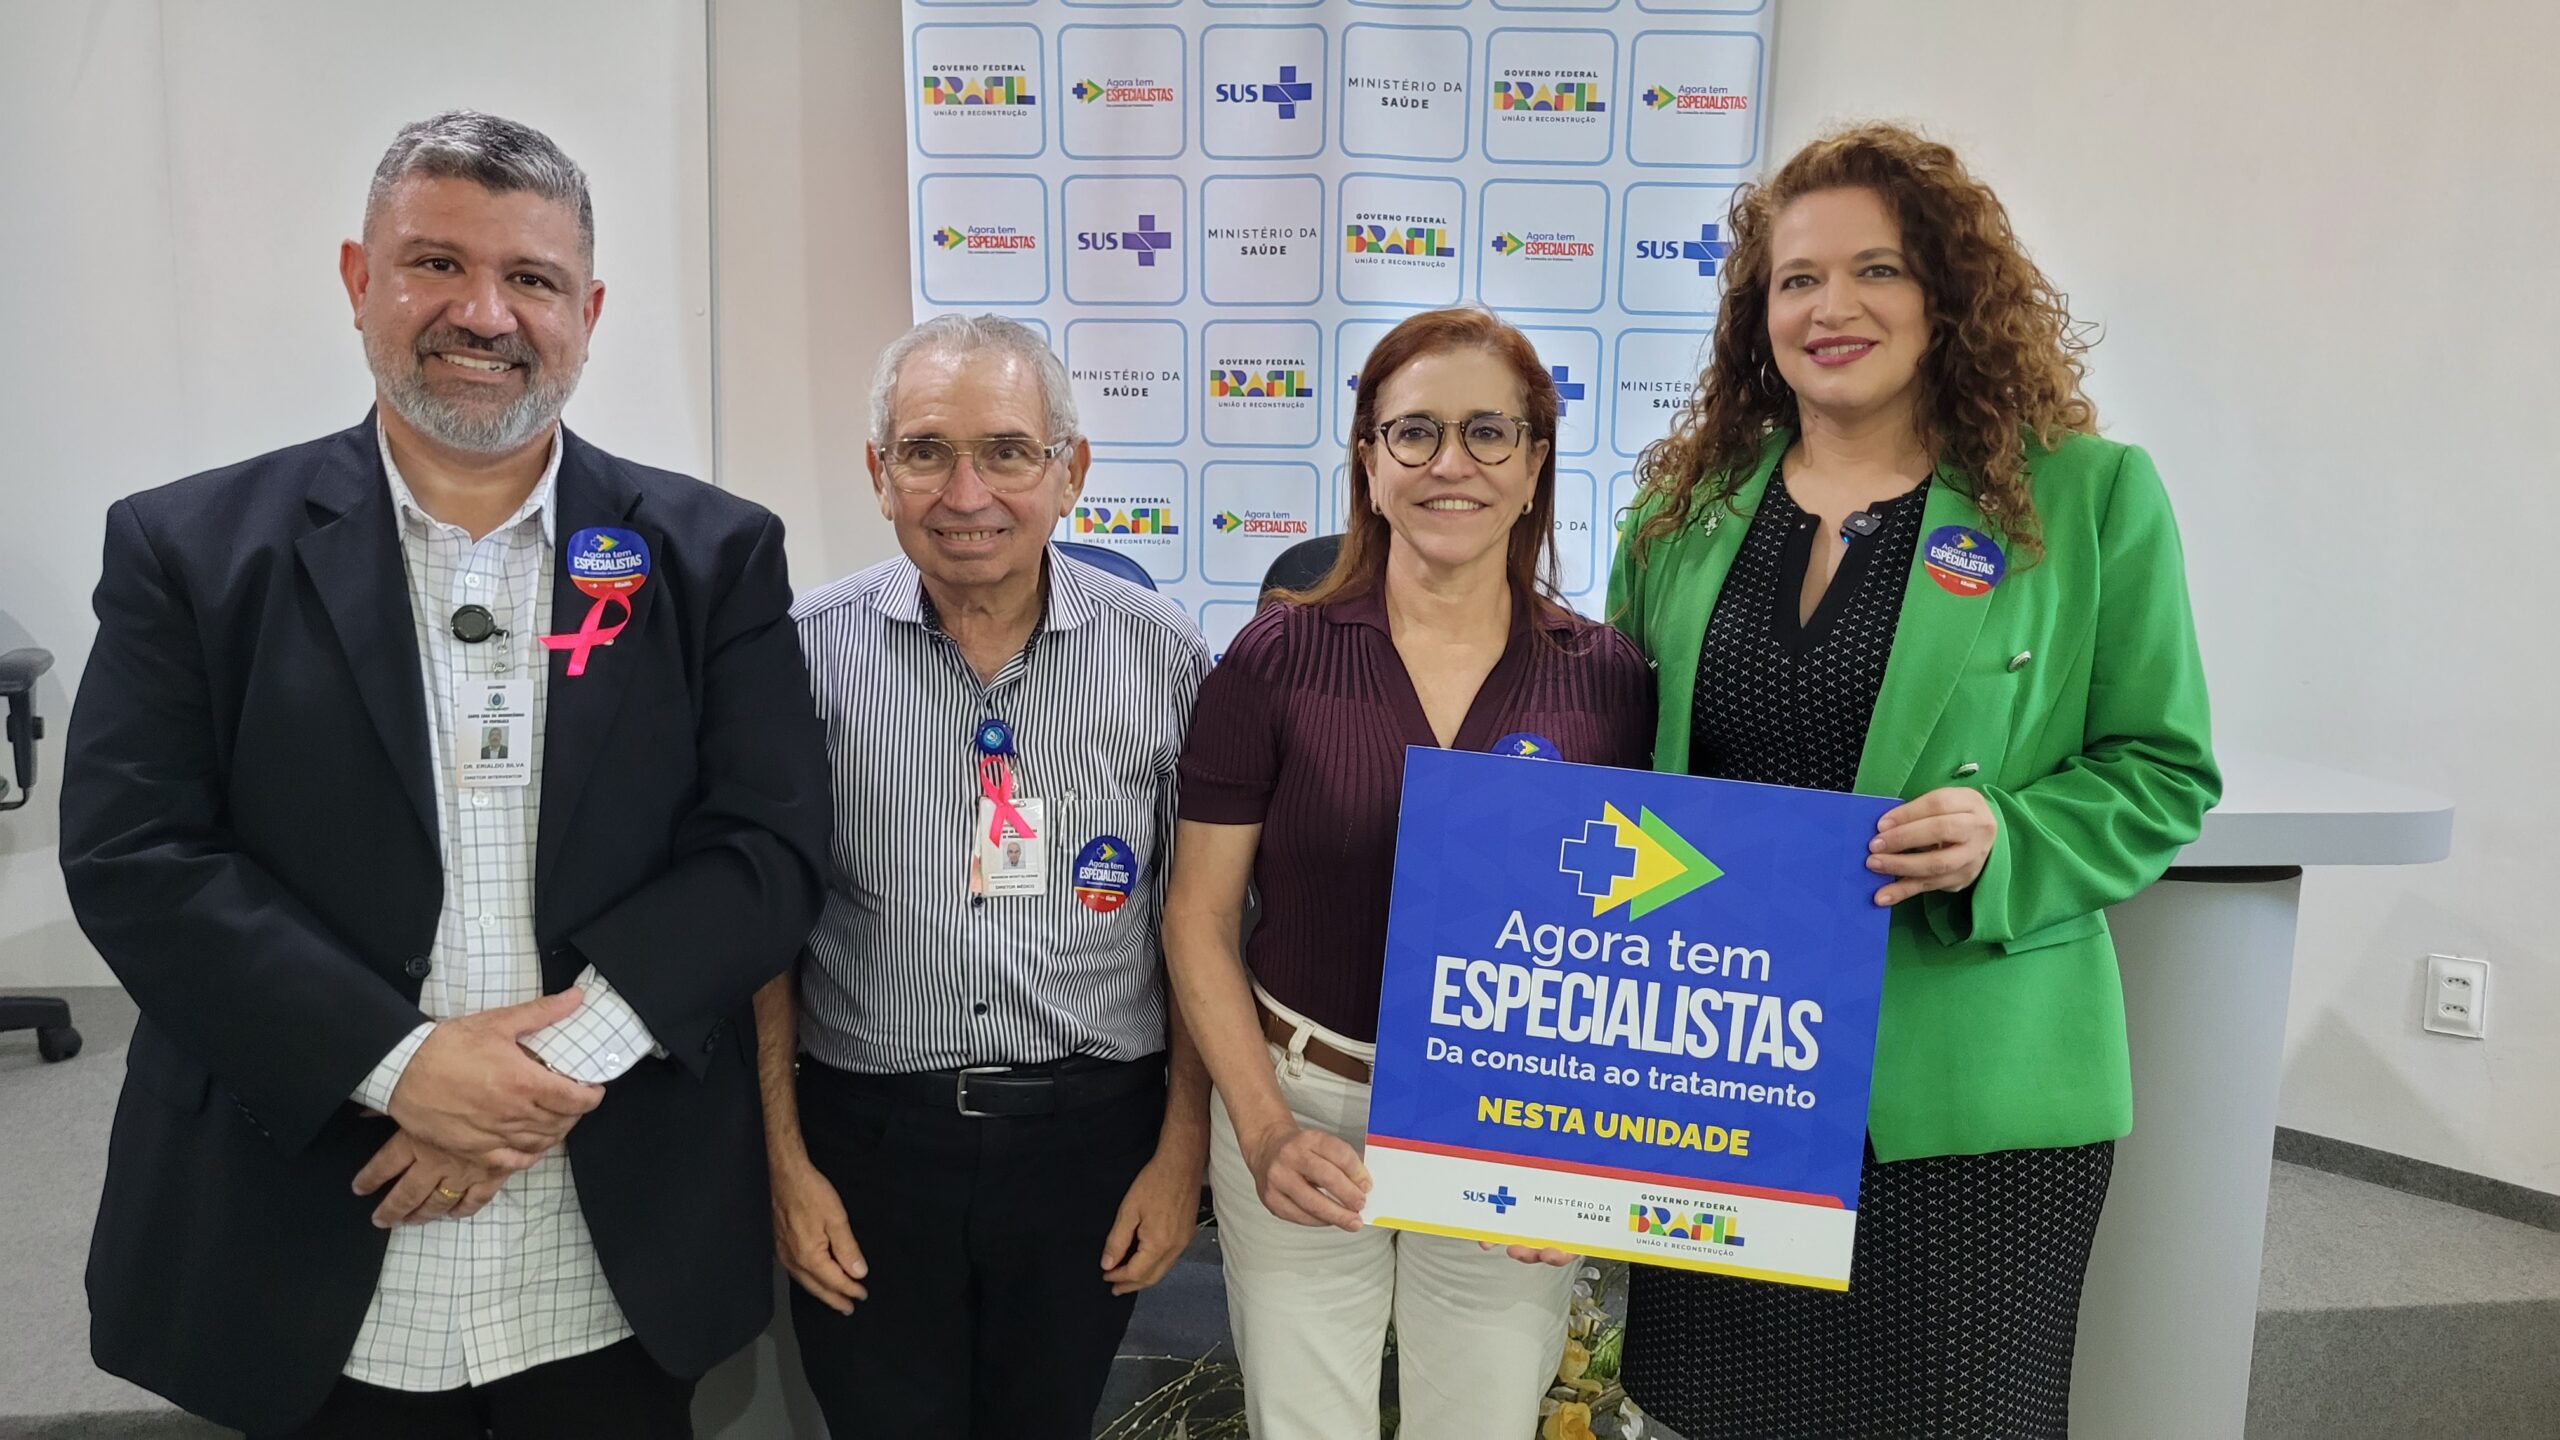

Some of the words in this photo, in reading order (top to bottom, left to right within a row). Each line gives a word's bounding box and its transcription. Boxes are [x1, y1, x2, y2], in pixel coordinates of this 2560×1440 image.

[1504, 69, 1551, 77] GOVERNO
[1555, 70, 1599, 78] FEDERAL
[1106, 78, 1134, 88] Agora
[1135, 78, 1154, 86] tem
[1348, 77, 1437, 92] MINISTÉRIO
[1443, 82, 1463, 92] DA
[923, 76, 1036, 105] BRASIL
[1106, 88, 1174, 102] ESPECIALISTAS
[1216, 84, 1258, 102] SUS
[1493, 81, 1606, 112] BRASIL
[1678, 85, 1707, 96] Agora
[1709, 86, 1728, 94] tem
[1381, 95, 1429, 109] SAÚDE
[1677, 95, 1748, 110] ESPECIALISTAS
[934, 109, 958, 117] UNIÃO
[959, 109, 965, 117] E
[968, 109, 1028, 117] RECONSTRUÇÃO
[1536, 116, 1596, 124] RECONSTRUÇÃO
[1356, 213, 1402, 221] GOVERNO
[1405, 216, 1447, 224] FEDERAL
[967, 225, 995, 235] Agora
[1208, 226, 1294, 239] MINISTÉRIO
[1299, 228, 1317, 238] DA
[1526, 231, 1554, 242] Agora
[1556, 233, 1575, 241] tem
[967, 235, 1036, 249] ESPECIALISTAS
[1077, 232, 1118, 250] SUS
[1346, 225, 1455, 257] BRASIL
[1240, 243, 1287, 256] SAÚDE
[1525, 242, 1594, 256] ESPECIALISTAS
[1636, 240, 1679, 260] SUS
[1388, 259, 1446, 268] RECONSTRUÇÃO
[1072, 368, 1155, 381] MINISTÉRIO
[1162, 371, 1181, 381] DA
[1210, 370, 1313, 397] BRASIL
[1621, 381, 1697, 392] MINISTÉR
[1103, 385, 1149, 397] SAÚDE
[1075, 507, 1179, 534] BRASIL
[1245, 510, 1271, 520] Agora
[1273, 511, 1290, 519] tem
[1244, 520, 1307, 534] ESPECIALISTAS
[1570, 521, 1587, 531] DA
[1107, 538, 1113, 546] E
[1114, 538, 1171, 546] RECONSTRUÇÃO
[583, 550, 612, 559] Agora
[613, 550, 632, 558] tem
[1941, 543, 1967, 557] Agora
[1969, 552, 1987, 562] tem
[574, 554, 642, 570] ESPECIALISTAS
[1930, 546, 1995, 575] ESPECIALISTAS
[1088, 859, 1109, 869] Agora
[1110, 862, 1124, 870] tem
[1079, 866, 1129, 884] ESPECIALISTAS
[1494, 910, 1650, 967] Agora
[1668, 930, 1771, 981] tem
[1430, 955, 1823, 1071] ESPECIALISTAS
[1426, 1037, 1463, 1064] Da
[1470, 1048, 1596, 1082] consulta
[1603, 1065, 1640, 1087] ao
[1648, 1066, 1816, 1109] tratamento
[1477, 1096, 1586, 1135] NESTA
[1594, 1111, 1751, 1157] UNIDADE
[1463, 1190, 1486, 1202] SUS
[1641, 1193, 1690, 1206] GOVERNO
[1694, 1200, 1738, 1212] FEDERAL
[1534, 1195, 1594, 1210] MINISTÉRIO
[1599, 1203, 1612, 1212] DA
[1577, 1212, 1611, 1223] SAÚDE
[1628, 1203, 1745, 1247] BRASIL
[1636, 1238, 1661, 1246] UNIÃO
[1671, 1243, 1735, 1257] RECONSTRUÇÃO
